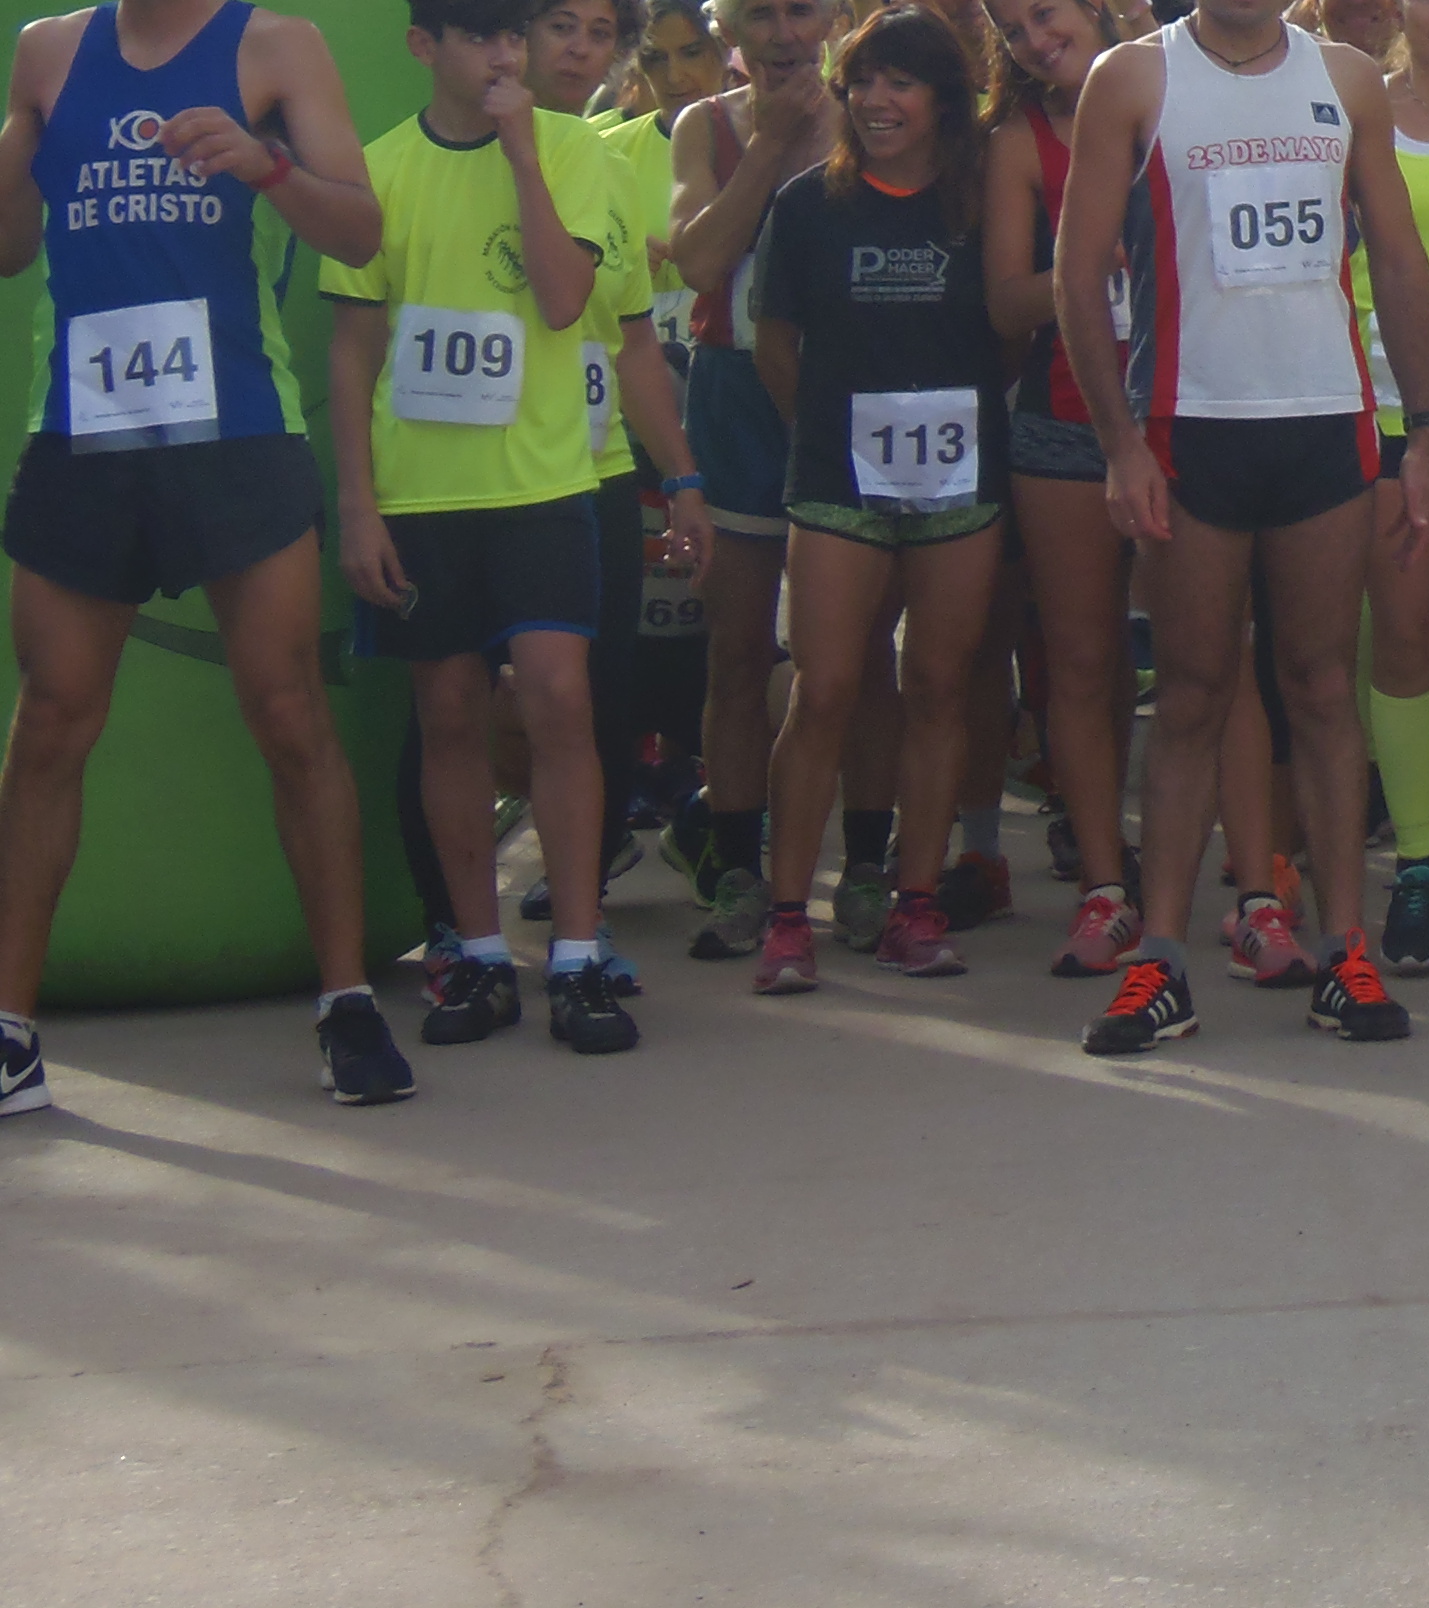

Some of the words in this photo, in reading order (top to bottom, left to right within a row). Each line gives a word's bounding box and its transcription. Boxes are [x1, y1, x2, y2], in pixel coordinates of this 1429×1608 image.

[76, 156, 208, 193] ATLETAS
[1187, 143, 1226, 170] 25
[1227, 137, 1270, 166] DE
[1271, 135, 1343, 164] MAYO
[67, 197, 99, 231] DE
[108, 192, 222, 225] CRISTO
[1229, 197, 1325, 250] 055
[88, 335, 200, 394] 144
[413, 327, 515, 378] 109
[869, 422, 966, 466] 113
